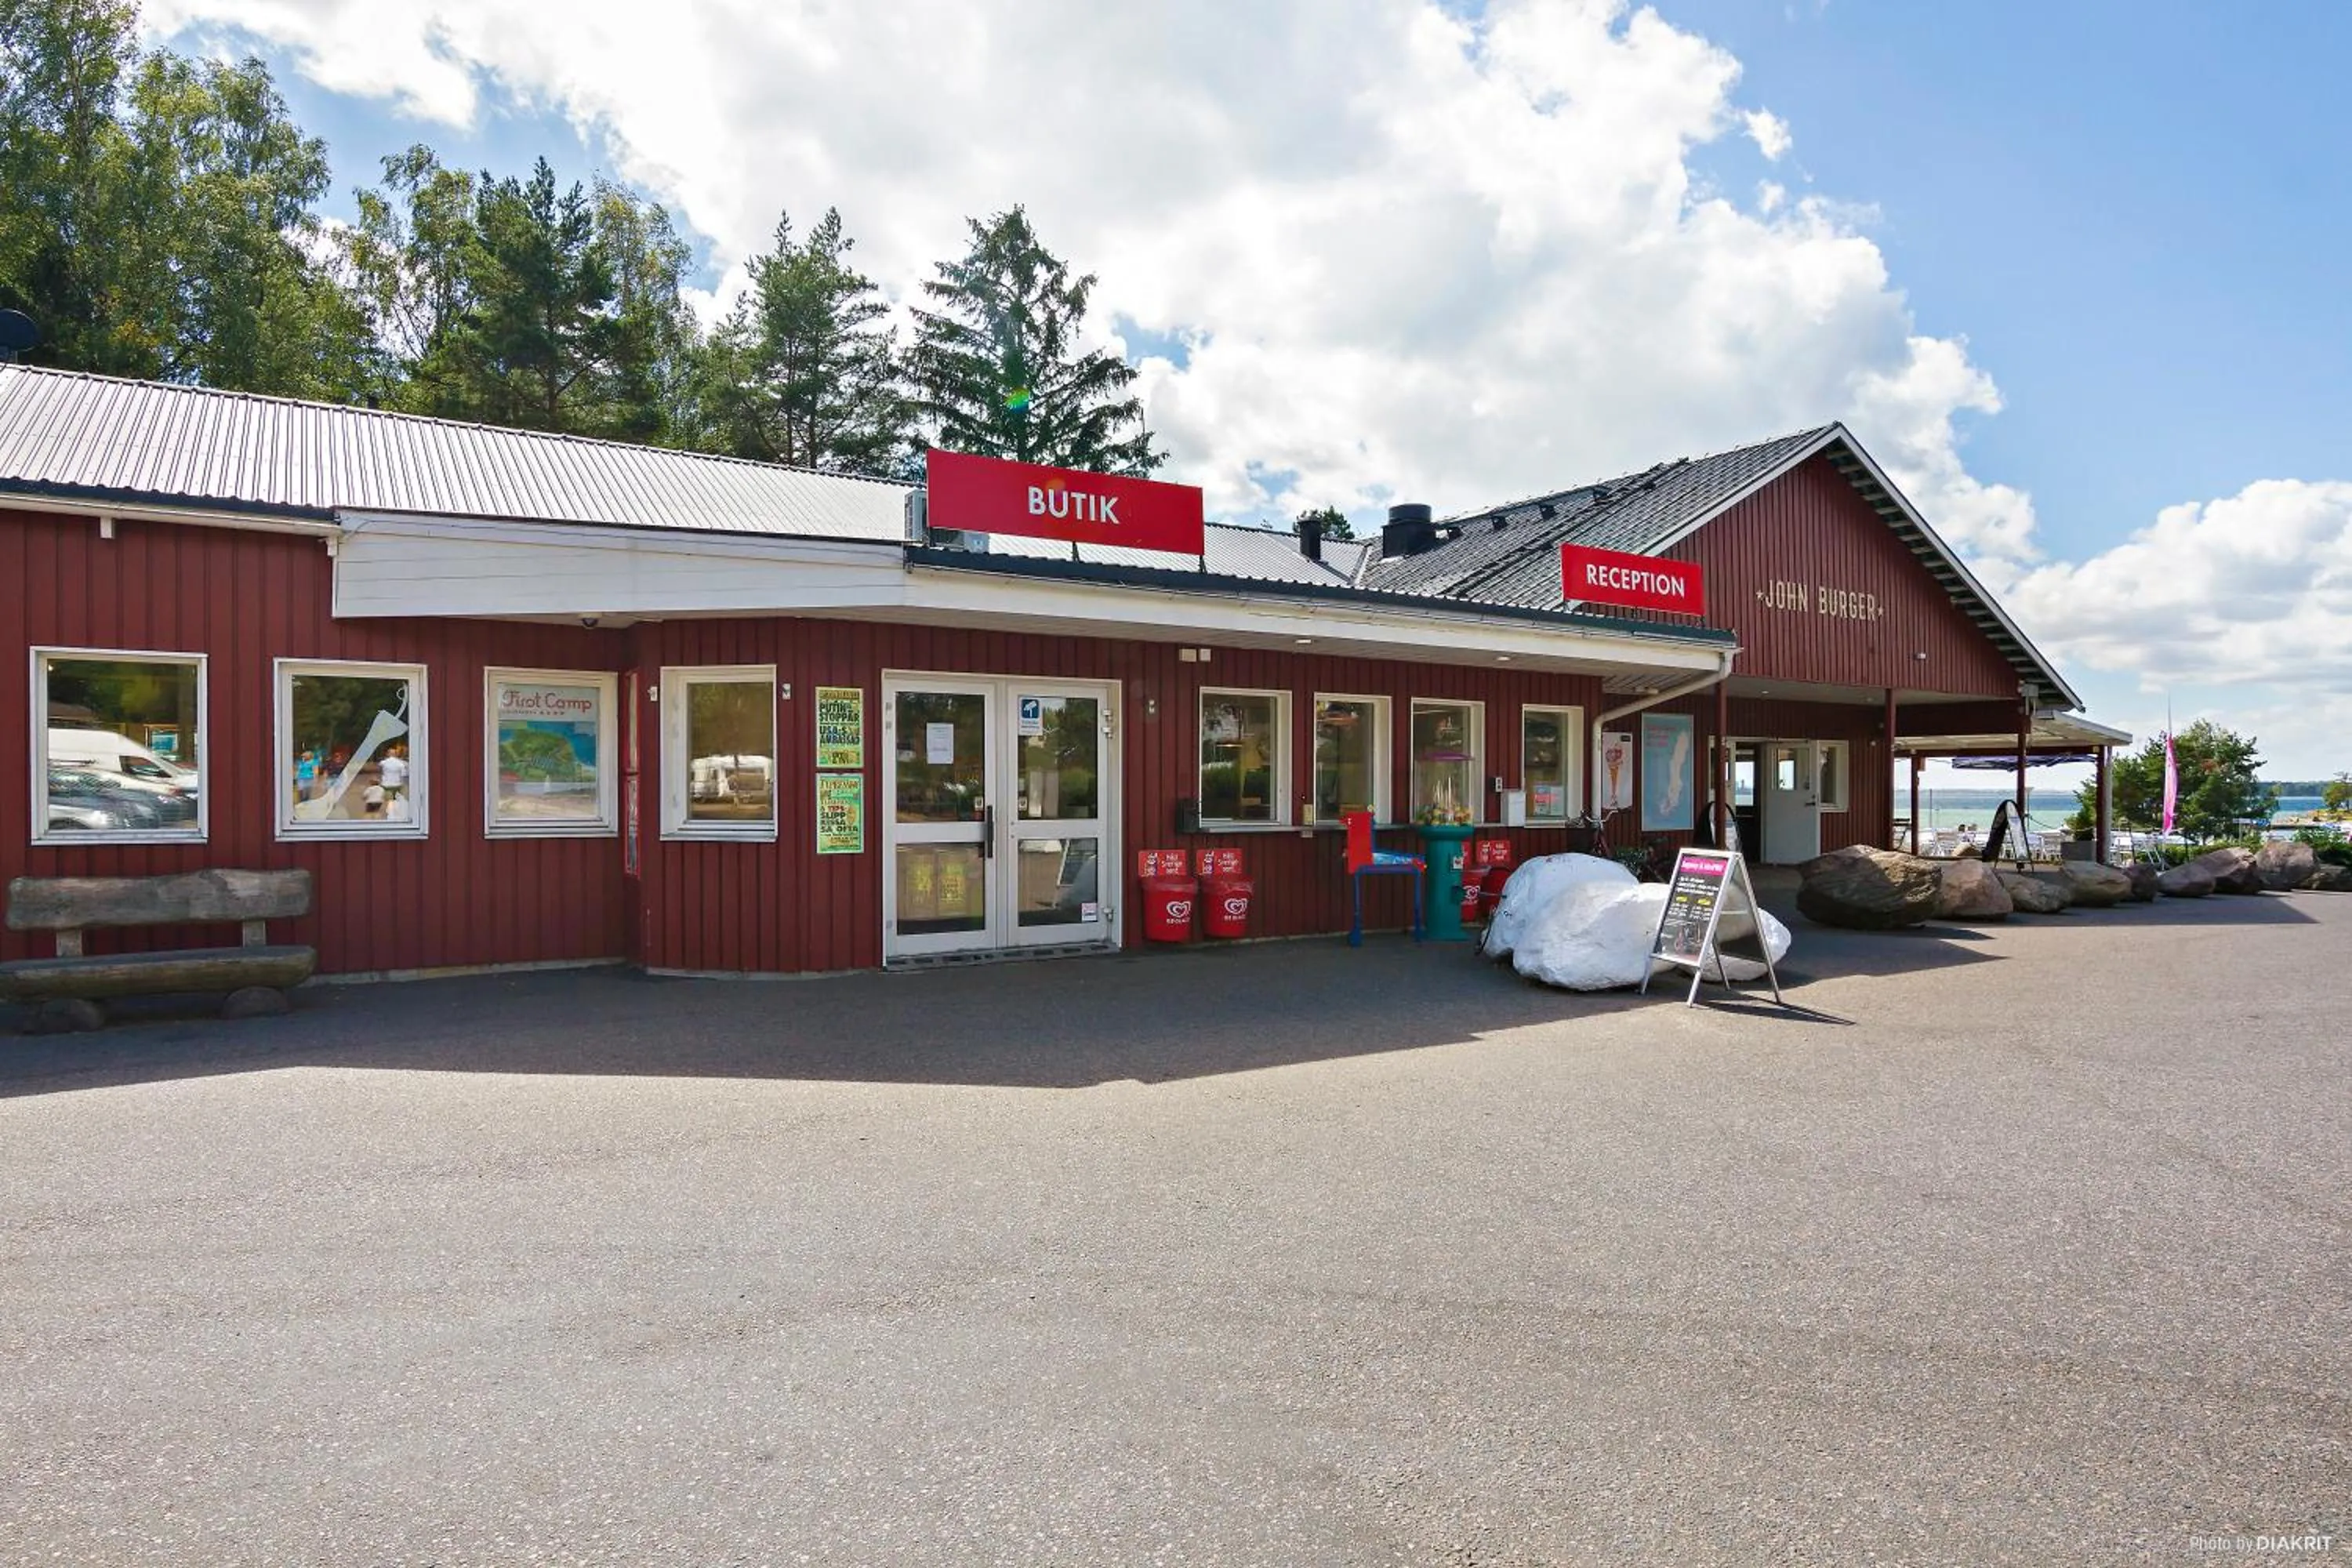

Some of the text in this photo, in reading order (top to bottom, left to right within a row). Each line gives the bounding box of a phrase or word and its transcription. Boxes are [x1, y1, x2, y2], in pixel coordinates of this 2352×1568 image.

[1028, 485, 1120, 524] BUTIK
[1586, 564, 1685, 598] RECEPTION
[1766, 579, 1875, 621] JOHN BURGER
[545, 692, 592, 713] Camp
